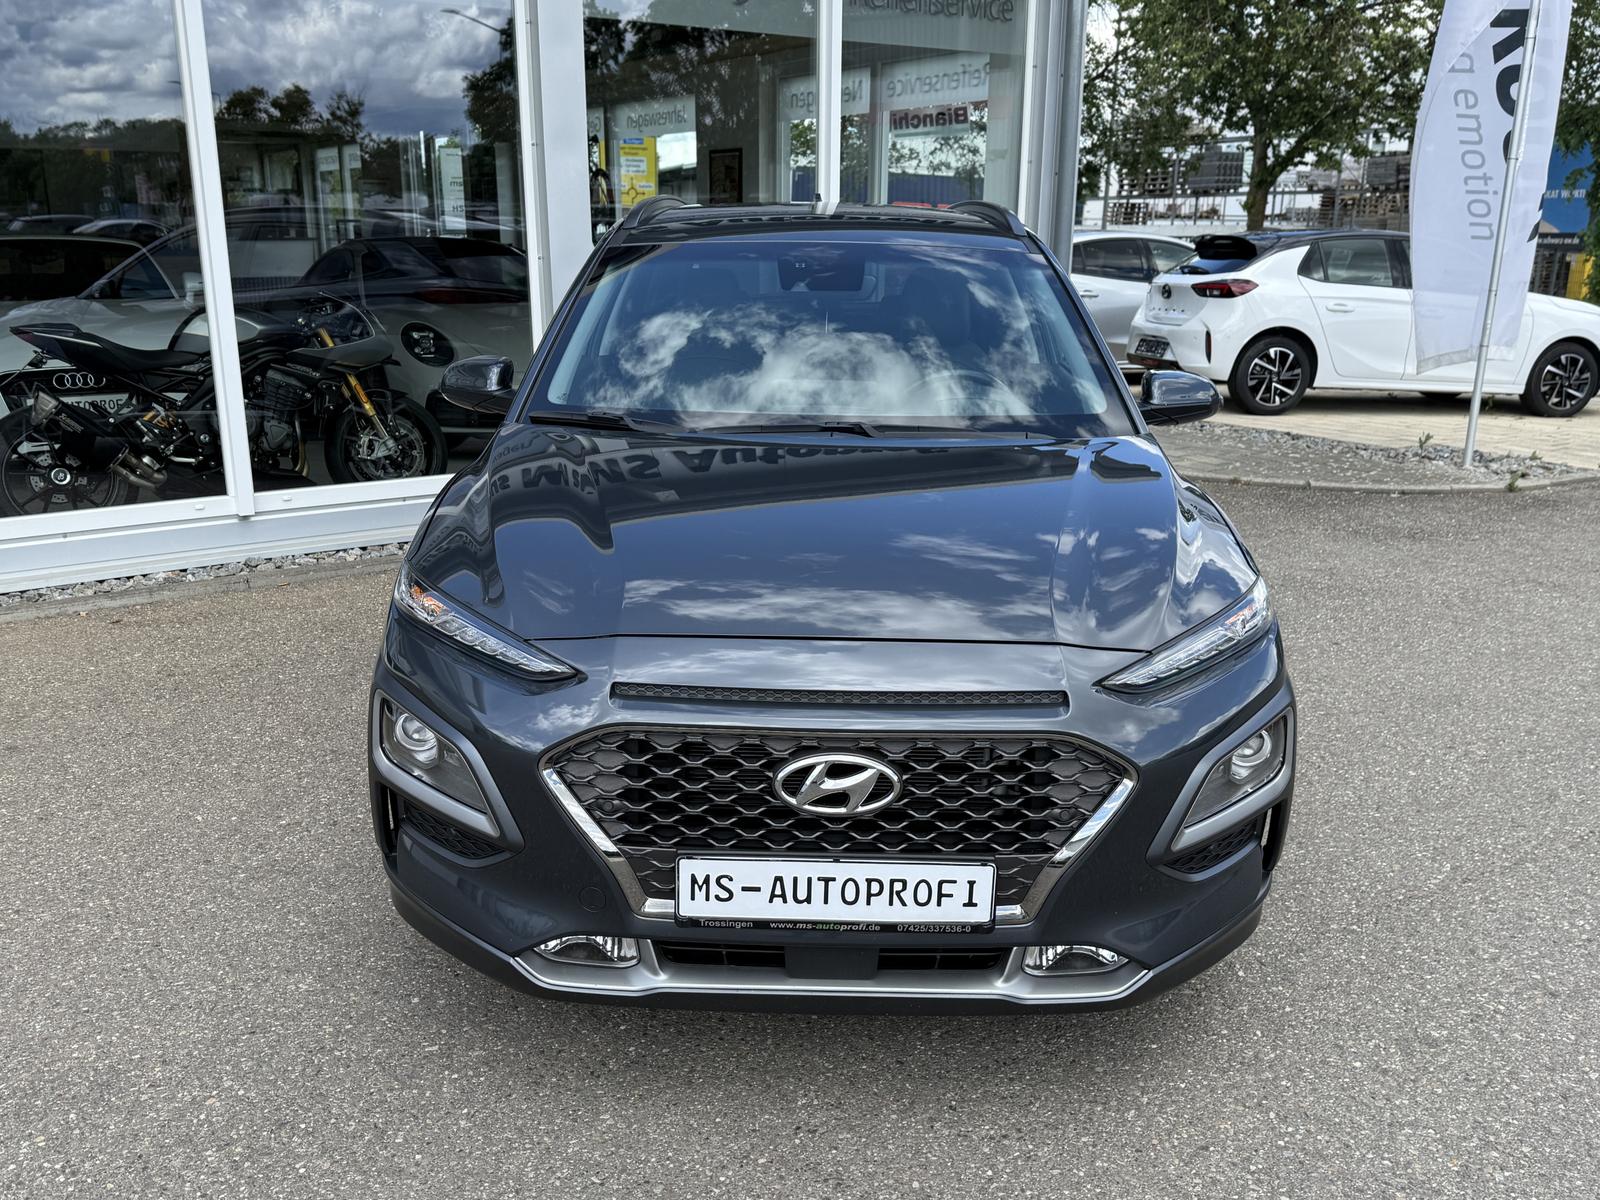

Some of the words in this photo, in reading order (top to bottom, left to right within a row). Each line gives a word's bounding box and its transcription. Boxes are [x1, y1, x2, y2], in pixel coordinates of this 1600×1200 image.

[1453, 88, 1498, 241] emotion
[690, 873, 978, 907] MS-AUTOPROFI
[700, 919, 753, 929] Trossingen
[769, 921, 880, 932] www.ms-autoprofi.de
[897, 924, 971, 934] 07425/337536-0
